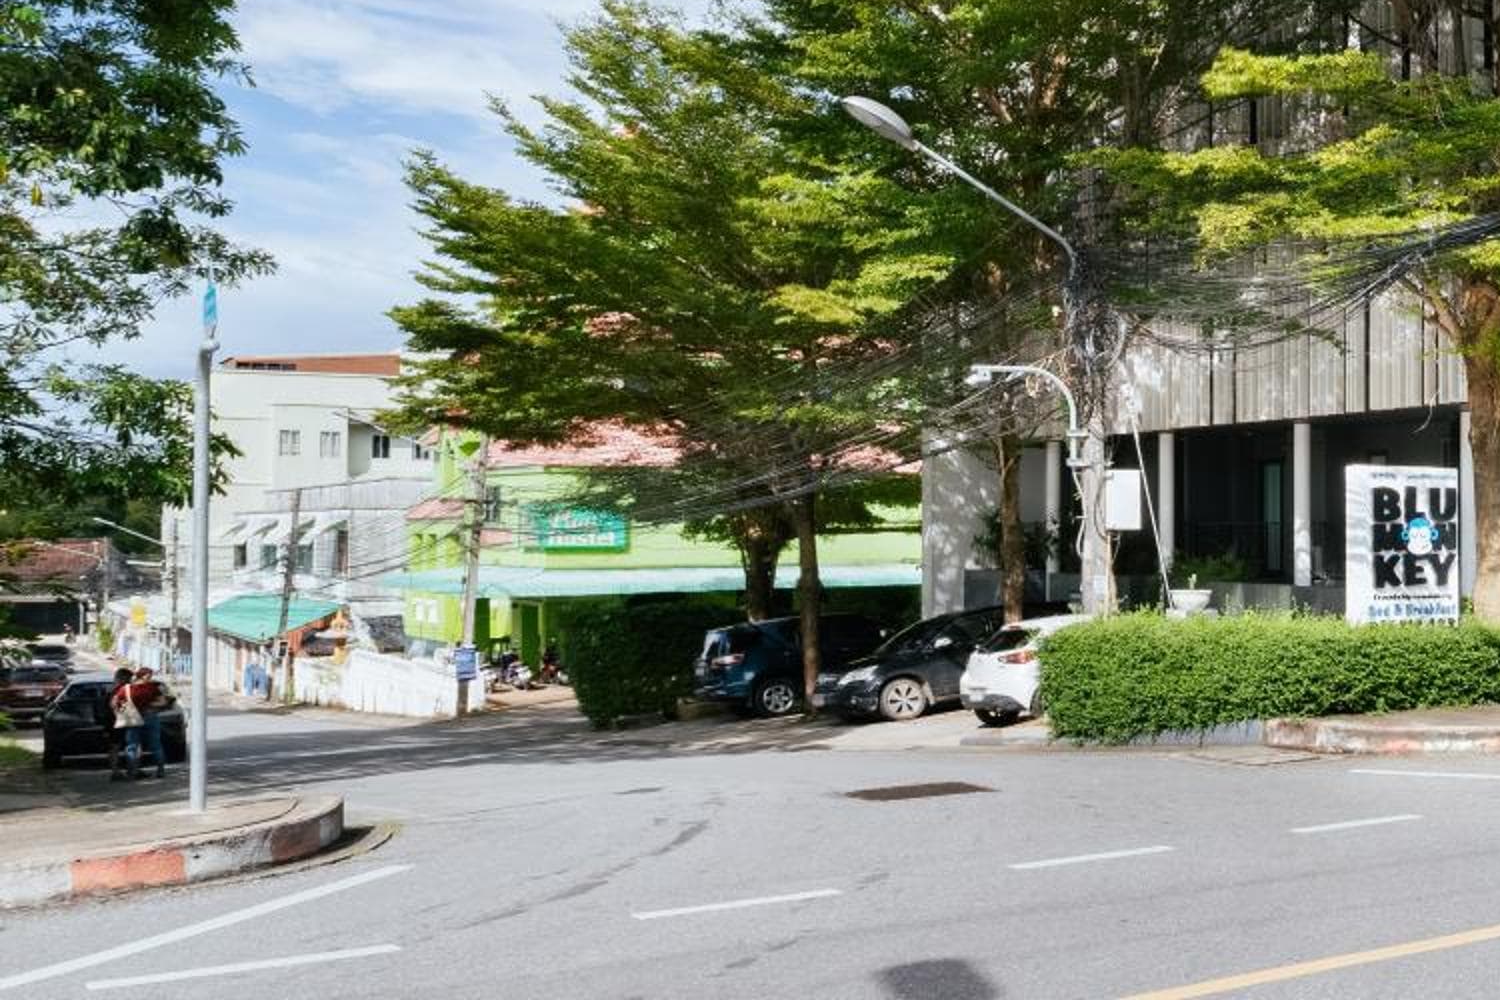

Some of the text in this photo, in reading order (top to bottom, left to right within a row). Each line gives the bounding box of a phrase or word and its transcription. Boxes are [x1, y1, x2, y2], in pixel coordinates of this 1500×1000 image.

[1373, 486, 1457, 522] BLU
[1373, 523, 1457, 551] MN
[1374, 552, 1457, 588] KEY
